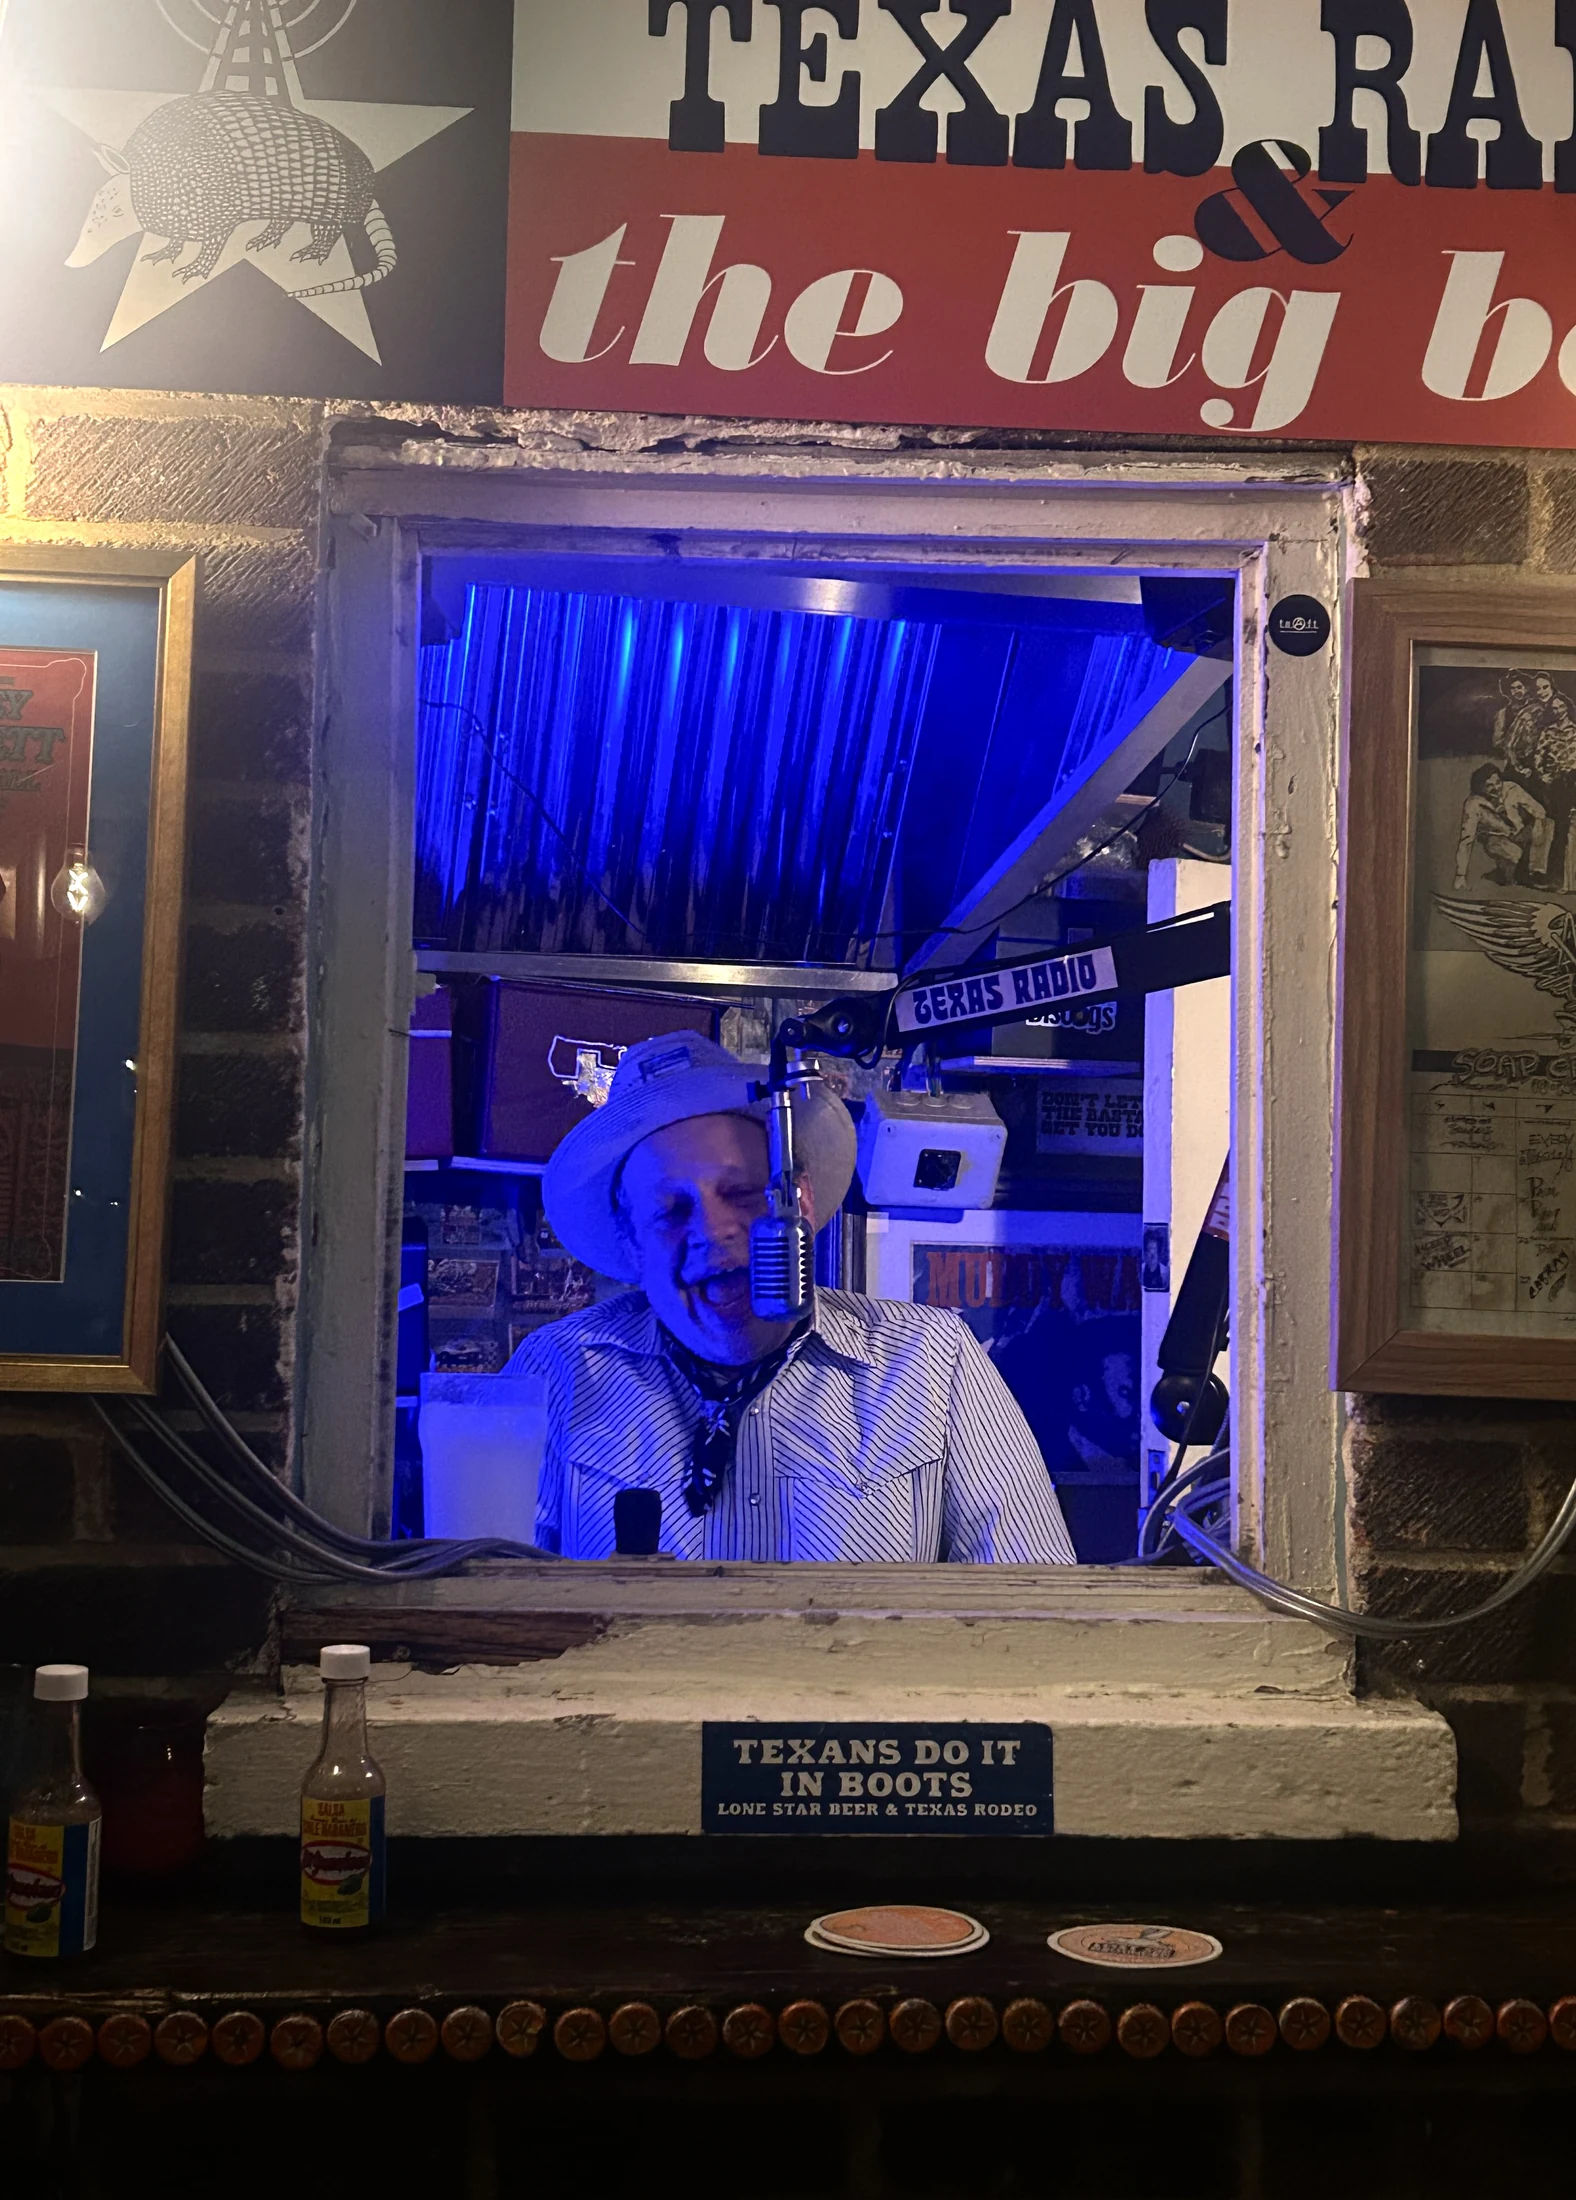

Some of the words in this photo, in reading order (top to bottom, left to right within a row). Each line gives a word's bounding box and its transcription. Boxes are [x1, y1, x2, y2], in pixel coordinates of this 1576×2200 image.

[648, 0, 1228, 177] TEXAS
[1317, 0, 1576, 193] RA
[1194, 139, 1356, 265] &
[538, 212, 905, 376] the
[983, 229, 1342, 432] big
[1420, 249, 1576, 402] b
[911, 974, 1006, 1025] TEXAS
[1011, 953, 1098, 1006] RADIO
[1451, 1048, 1540, 1080] SOAP
[1085, 1122, 1121, 1137] YOU
[733, 1739, 902, 1765] TEXANS
[914, 1739, 970, 1766] DO
[981, 1740, 1022, 1766] IT
[780, 1771, 823, 1797] IN
[838, 1771, 974, 1798] BOOTS
[717, 1803, 767, 1817] LONE
[772, 1803, 822, 1817] STAR
[829, 1803, 879, 1817] BEER
[885, 1803, 899, 1817] &
[905, 1803, 968, 1817] TEXAS
[973, 1803, 1038, 1817] RODEO
